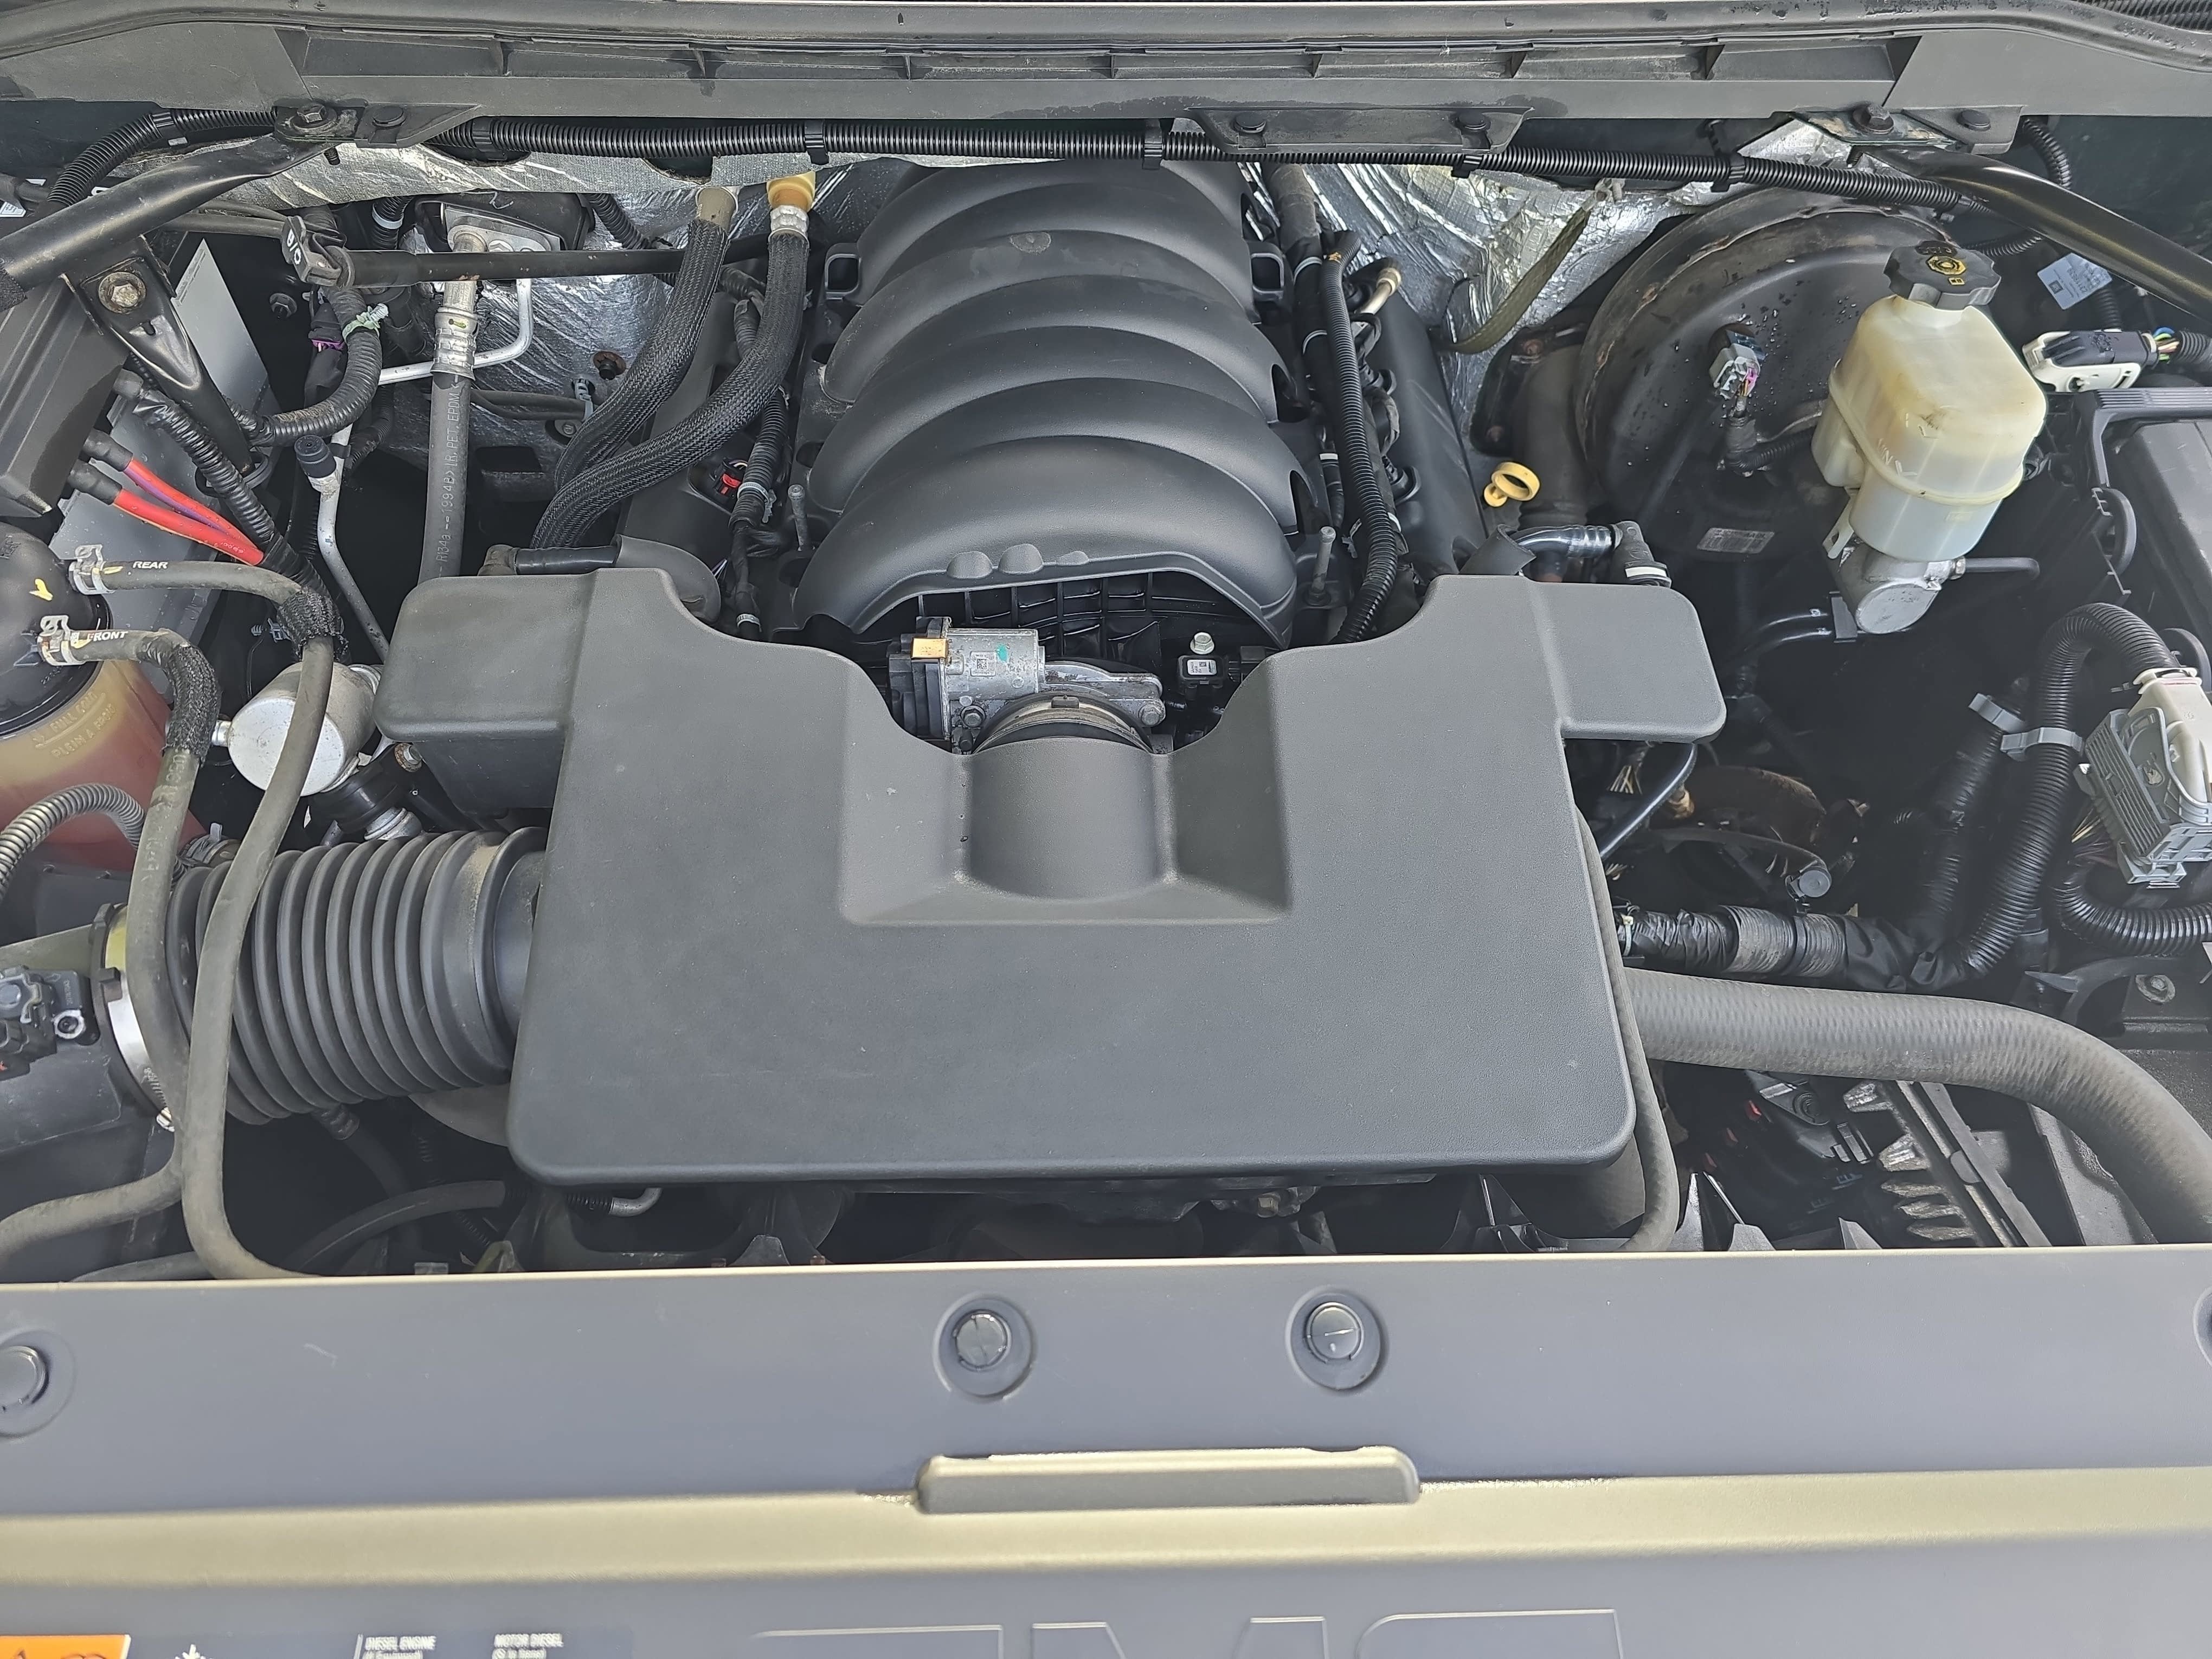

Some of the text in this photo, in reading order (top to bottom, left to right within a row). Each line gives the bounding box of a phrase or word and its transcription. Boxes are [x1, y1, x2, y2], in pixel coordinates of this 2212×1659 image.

[447, 392, 459, 421] EPDM
[446, 426, 459, 448] PET,
[436, 534, 451, 562] R134a
[132, 561, 168, 569] REAR
[87, 631, 128, 641] FRONT
[365, 1636, 436, 1650] DIESEL ENGINE
[530, 1633, 564, 1648] DIESEL
